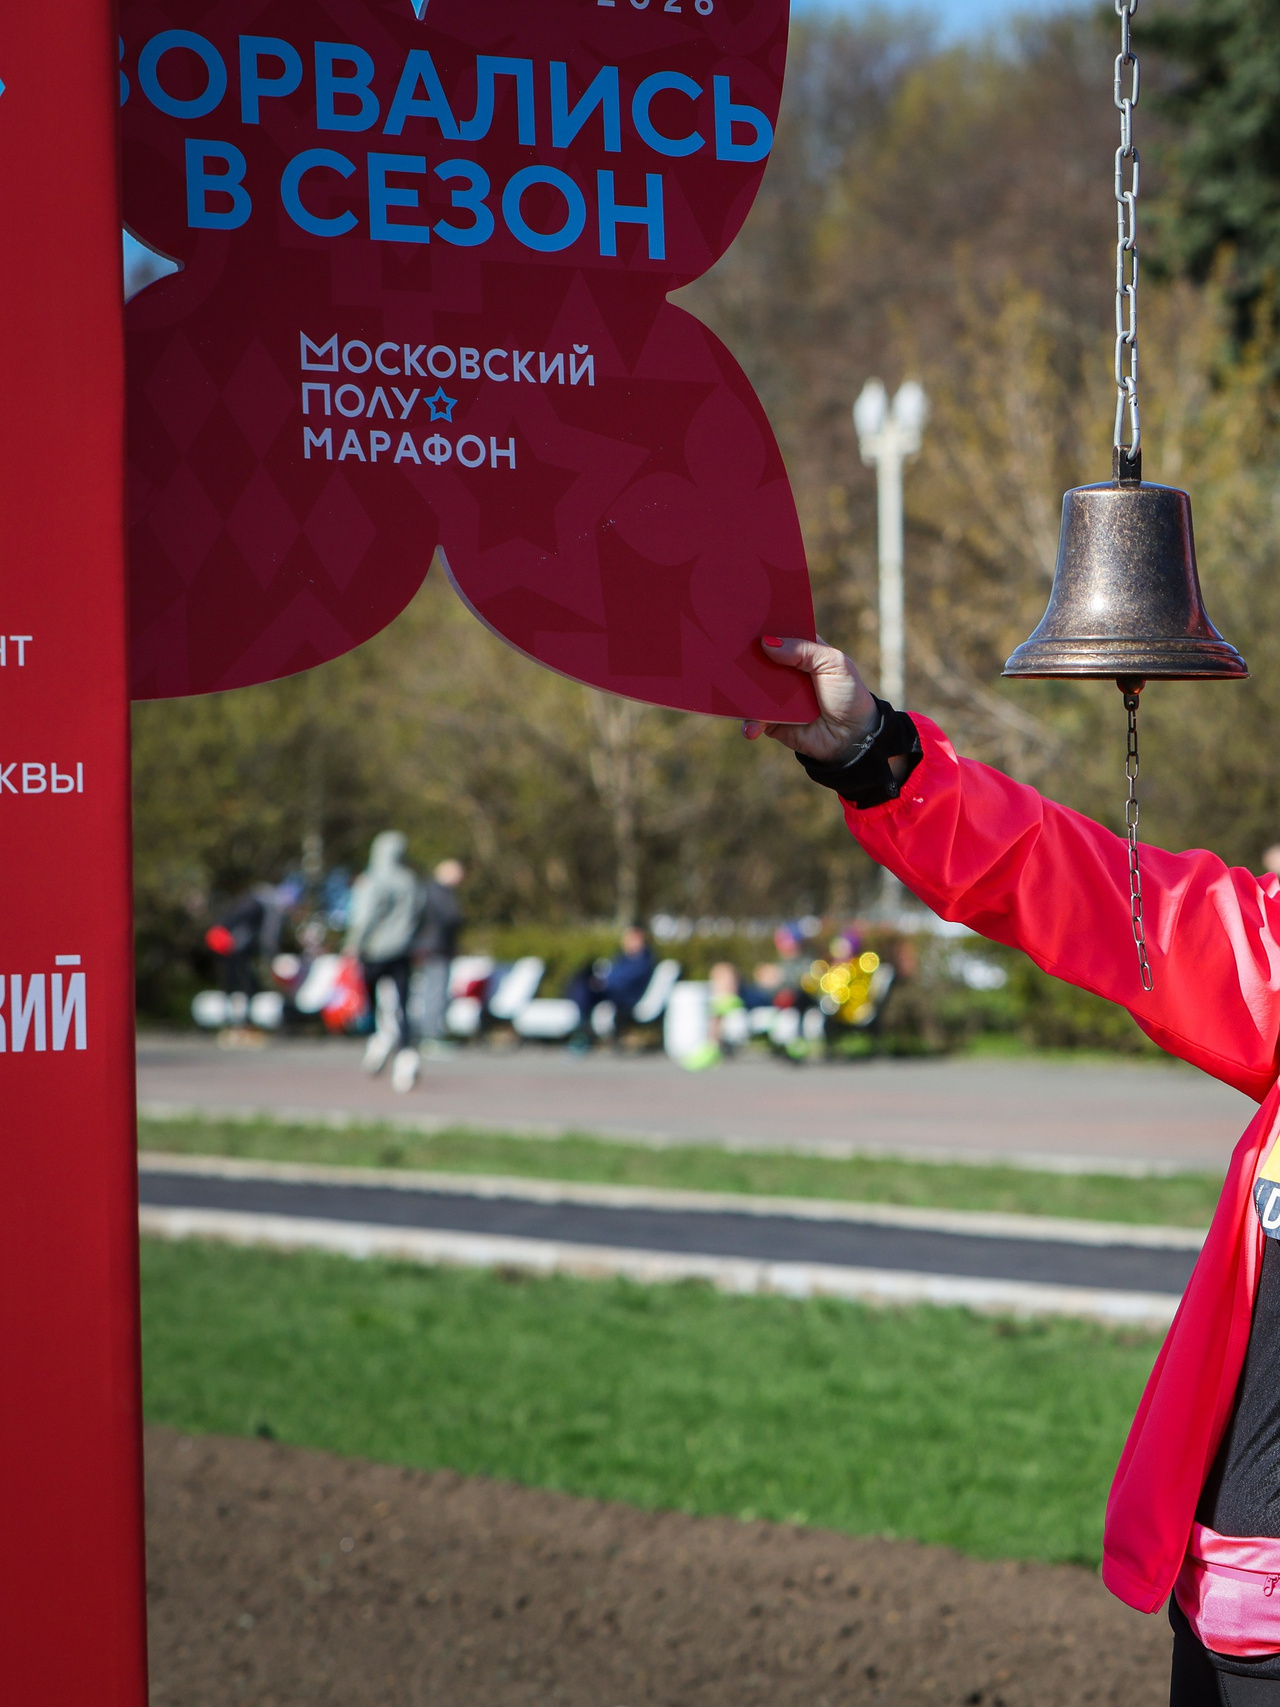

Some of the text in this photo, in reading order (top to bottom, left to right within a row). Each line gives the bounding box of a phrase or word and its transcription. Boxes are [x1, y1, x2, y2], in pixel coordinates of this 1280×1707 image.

[119, 28, 775, 164] ОРВАЛИСЬ
[184, 137, 666, 261] В СЕЗОН
[302, 382, 420, 422] ПОЛУ
[303, 426, 517, 470] МАРАФОН
[0, 953, 88, 1053] ИЙ
